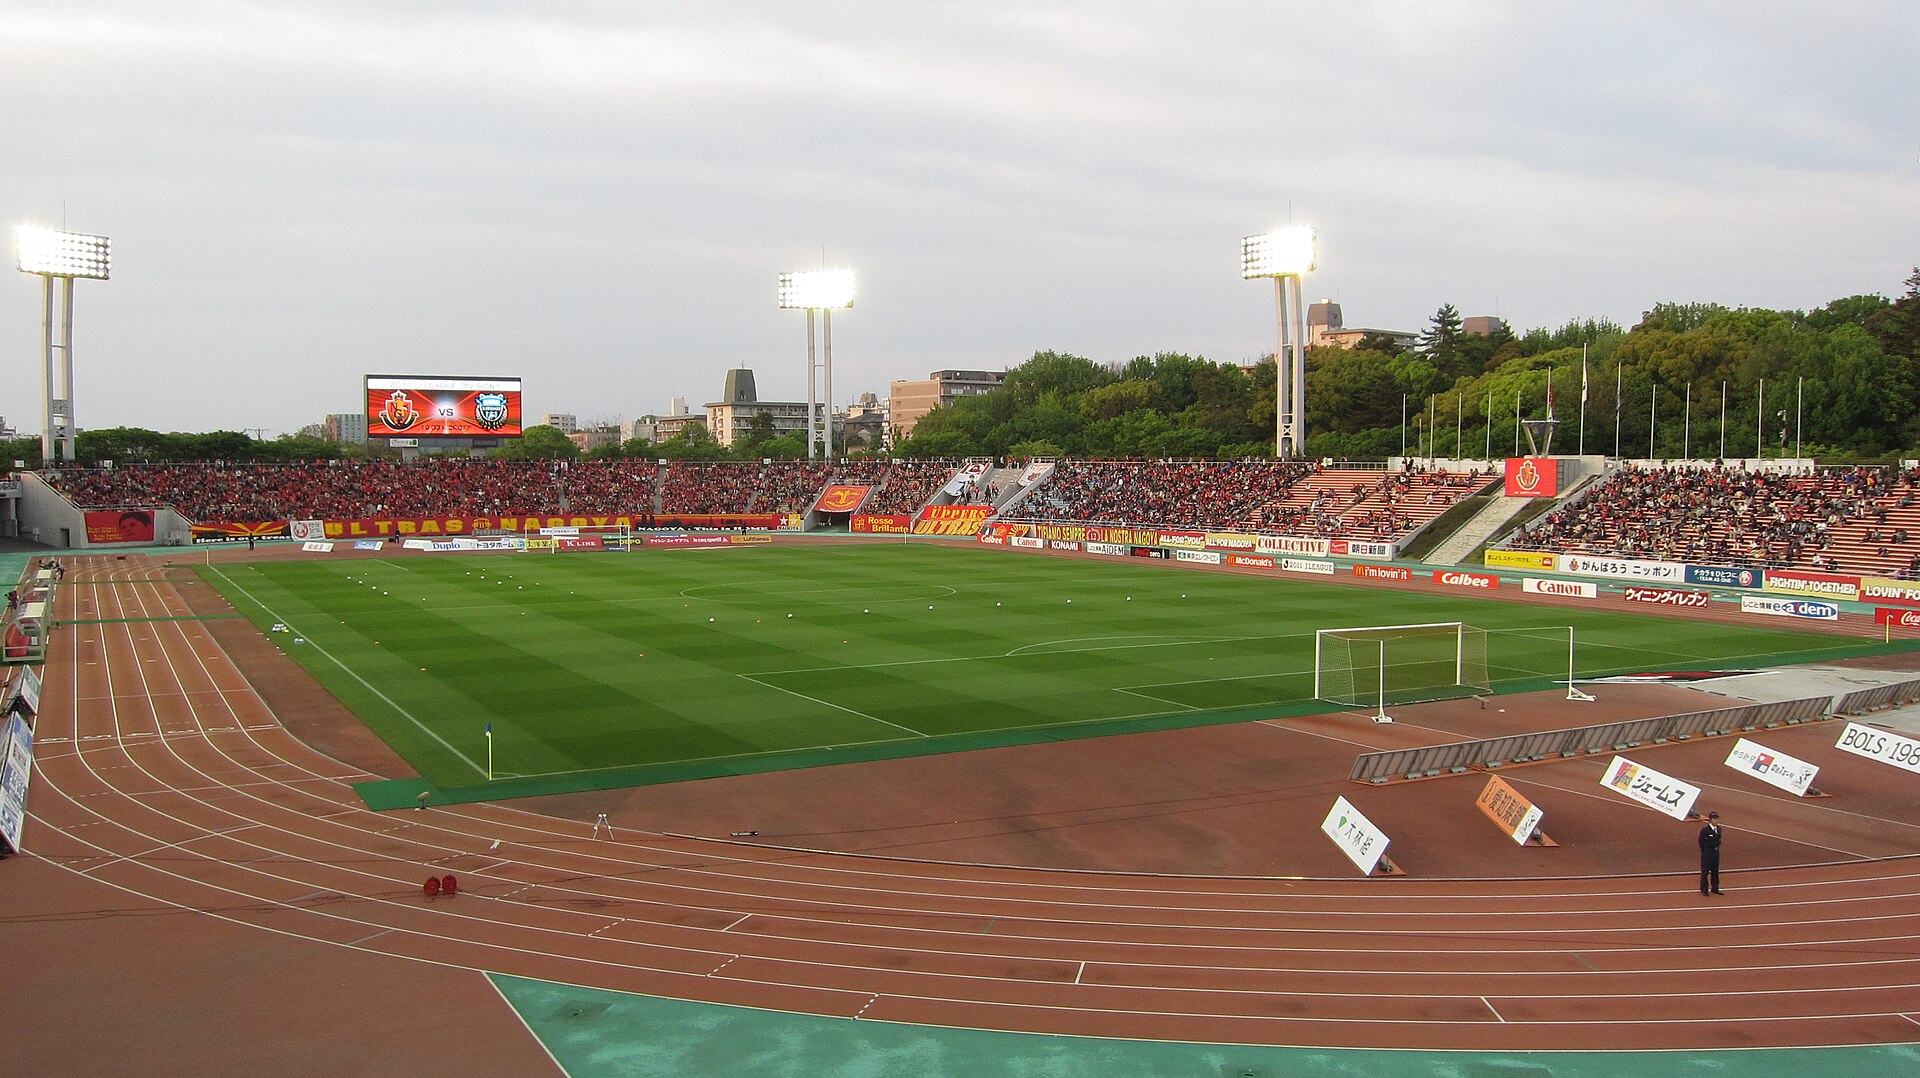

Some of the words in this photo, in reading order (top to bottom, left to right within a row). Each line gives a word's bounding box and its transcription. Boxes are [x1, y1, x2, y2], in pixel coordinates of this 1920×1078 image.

[325, 519, 464, 536] ULTRAS
[500, 516, 631, 530] NAGOYA
[868, 516, 894, 525] Rosso
[913, 520, 983, 535] ULTRAS
[872, 524, 909, 533] Brillante
[1062, 527, 1085, 541] SEMPRE
[980, 534, 1003, 545] Calbee
[1017, 538, 1037, 547] Canon
[1101, 529, 1109, 542] LA
[1109, 530, 1132, 544] NOSTRA
[1133, 531, 1158, 546] NAGOYA
[1228, 540, 1252, 549] NAGOYA
[432, 542, 461, 550] Duplo
[1051, 541, 1079, 551] KONAMI
[1258, 538, 1325, 553] COLLECTIVE
[1351, 543, 1386, 555] 朝日新聞
[1235, 556, 1273, 567] McDonald's
[1289, 561, 1303, 569] 2011
[1581, 560, 1627, 574] がんばろう
[1401, 569, 1408, 580] it
[1441, 572, 1489, 588] Calbee
[1536, 580, 1583, 596] Canon
[1808, 581, 1856, 596] TOGETHER
[1865, 585, 1904, 599] LOVIN'
[1841, 728, 1887, 755] BOLS
[1631, 774, 1686, 808] ジェームス
[1344, 821, 1374, 857] 大林組
